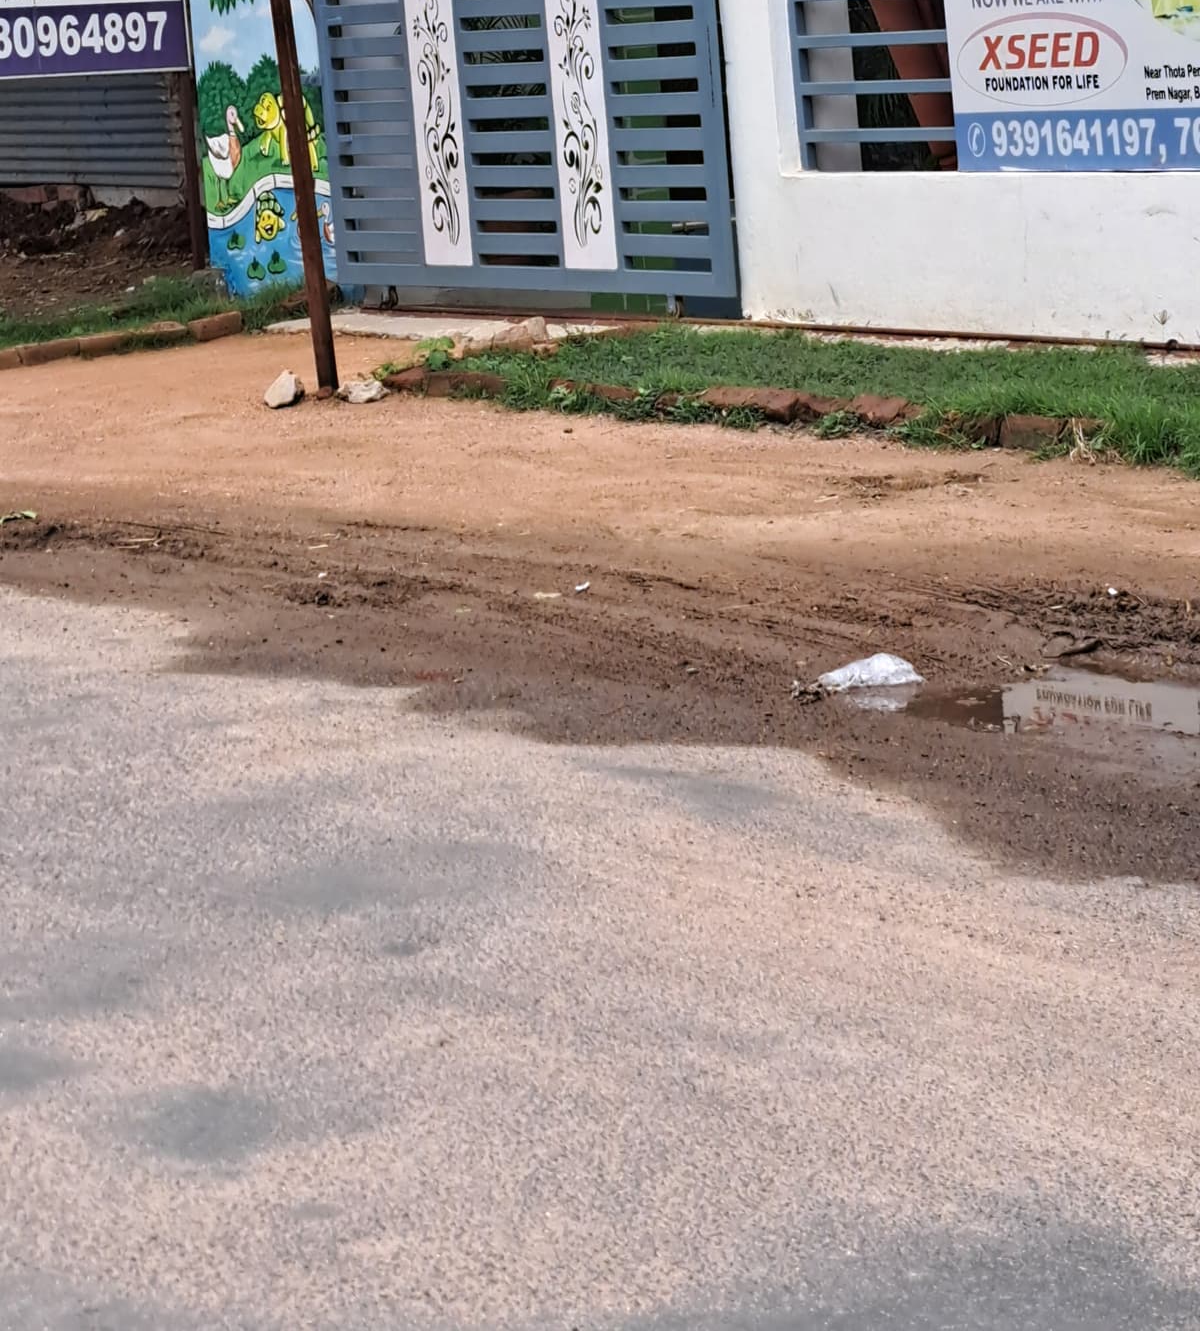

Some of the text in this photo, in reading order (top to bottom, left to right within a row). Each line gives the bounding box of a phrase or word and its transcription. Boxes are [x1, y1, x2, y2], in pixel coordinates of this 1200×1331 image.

[980, 30, 1099, 72] XSEED
[1144, 65, 1161, 79] Near
[1163, 64, 1185, 78] Thota
[985, 72, 1100, 93] FOUNDATION FOR LIFE
[1146, 87, 1166, 100] Prem
[1168, 86, 1192, 103] Nagar,
[992, 117, 1167, 164] 9391641197,
